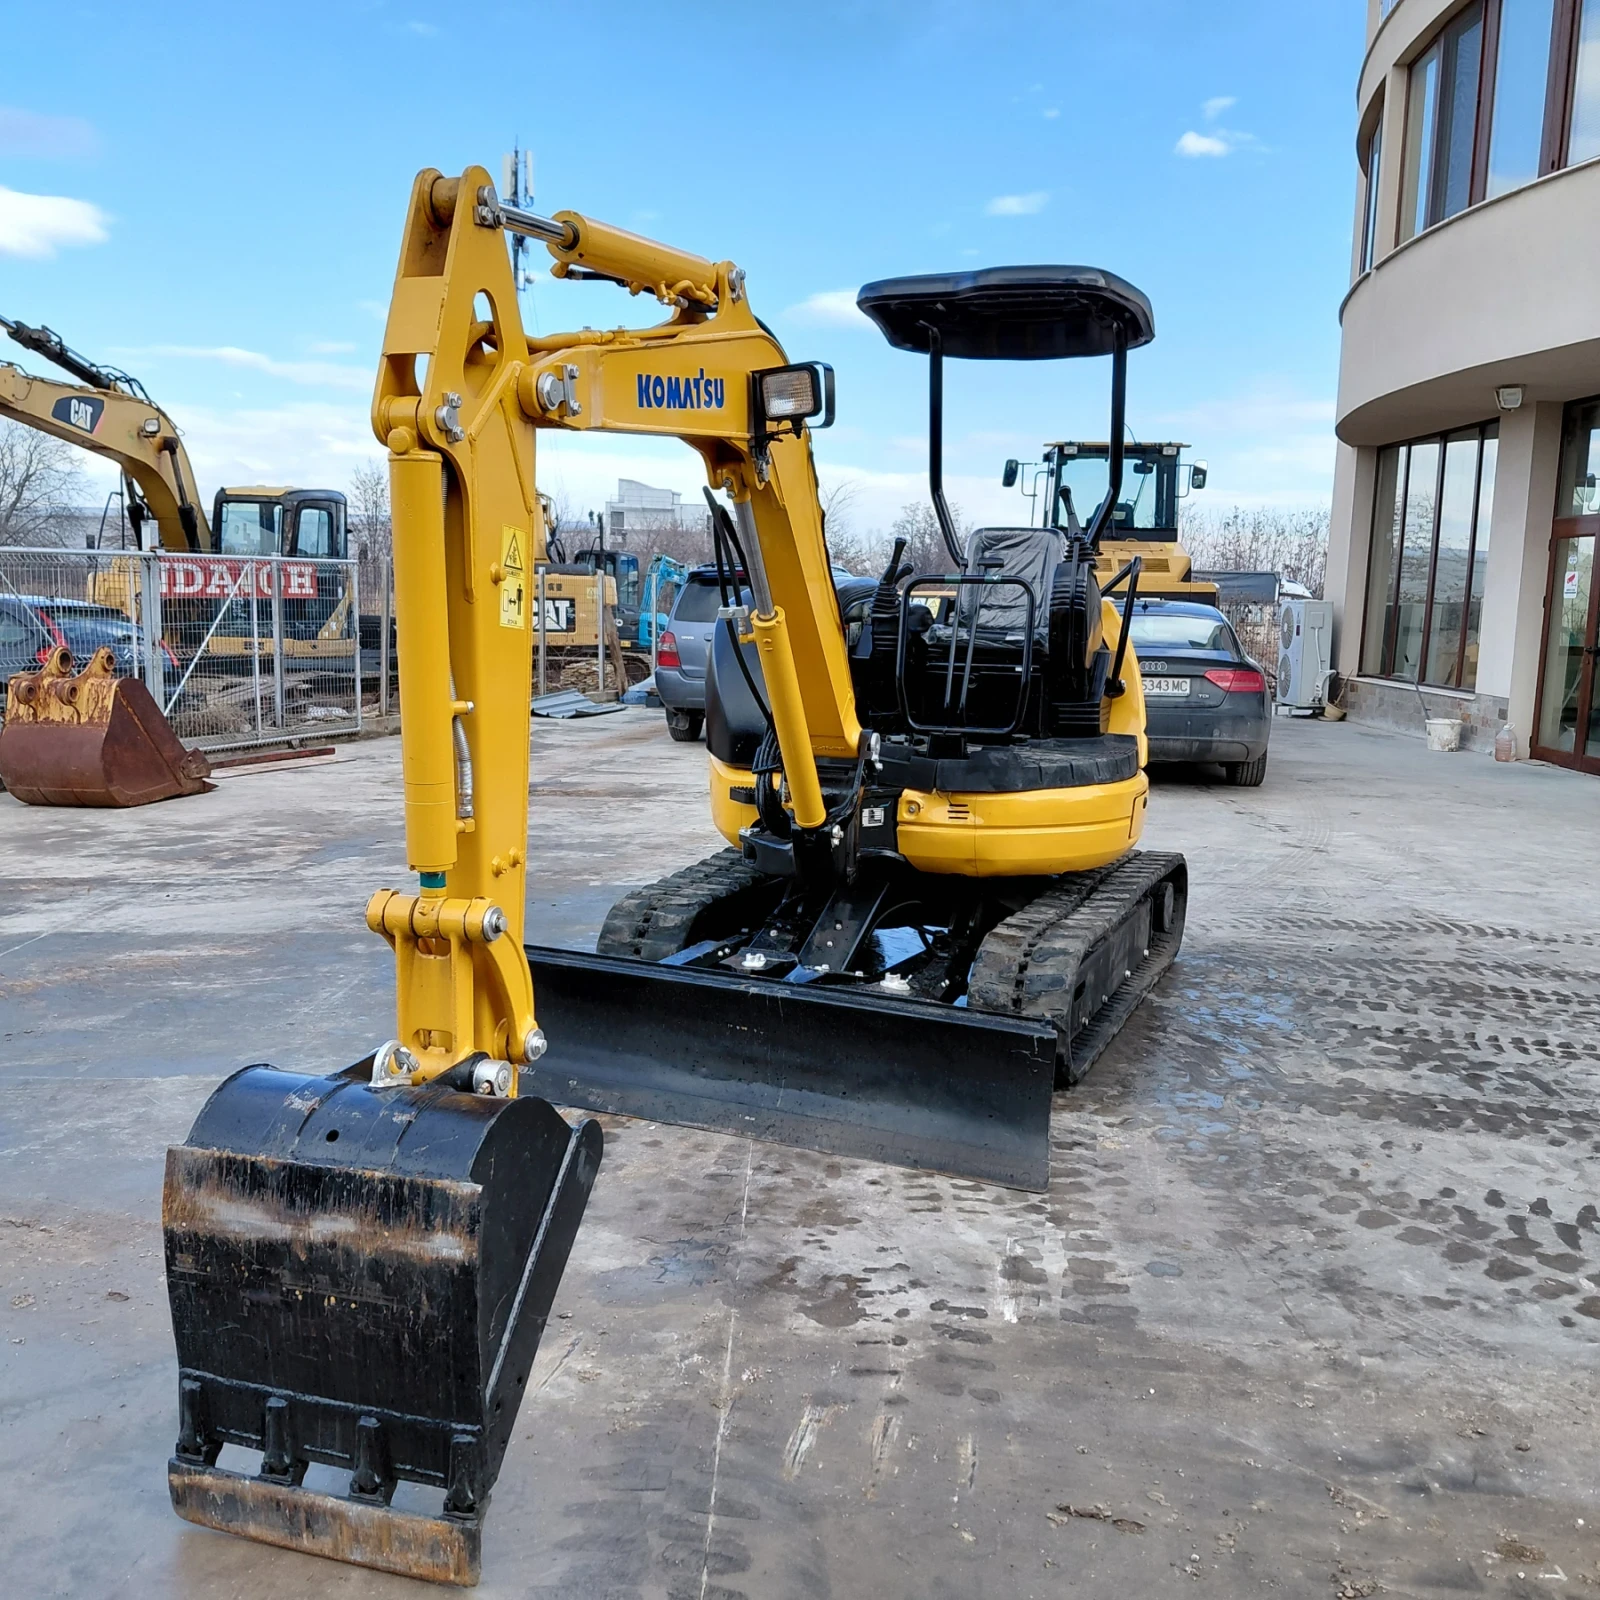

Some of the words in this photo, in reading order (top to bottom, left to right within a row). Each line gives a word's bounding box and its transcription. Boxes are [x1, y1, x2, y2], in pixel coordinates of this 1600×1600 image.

[637, 368, 725, 409] KOMATSU
[70, 398, 93, 430] CAT
[1142, 679, 1170, 691] 5343
[1171, 680, 1188, 692] MC
